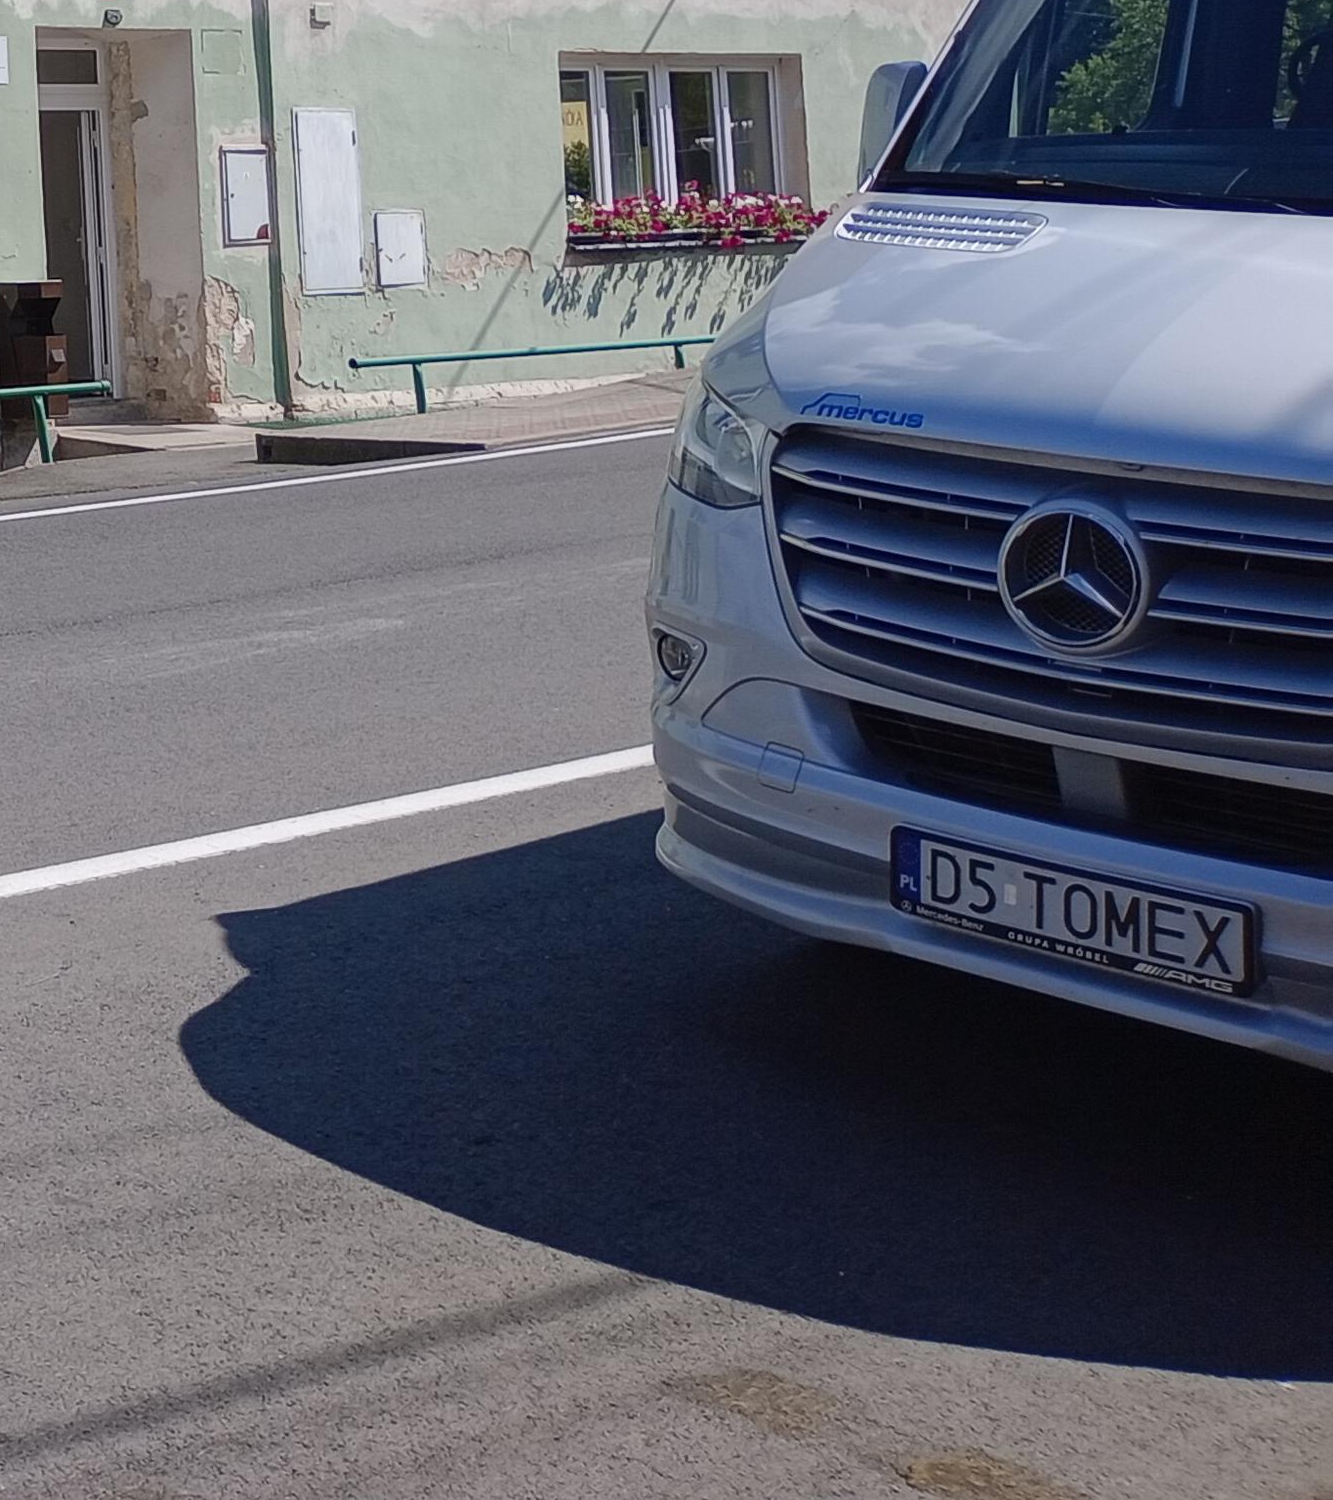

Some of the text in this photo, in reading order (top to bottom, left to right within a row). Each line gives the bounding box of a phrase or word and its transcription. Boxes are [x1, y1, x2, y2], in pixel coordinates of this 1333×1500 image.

[817, 403, 924, 429] mercus
[900, 874, 917, 892] PL
[916, 905, 985, 932] Mercedes-Benz
[930, 848, 1232, 975] D5 TOMEX
[1008, 931, 1110, 964] GRUPA WRÓBEL
[1164, 970, 1234, 994] AMG
